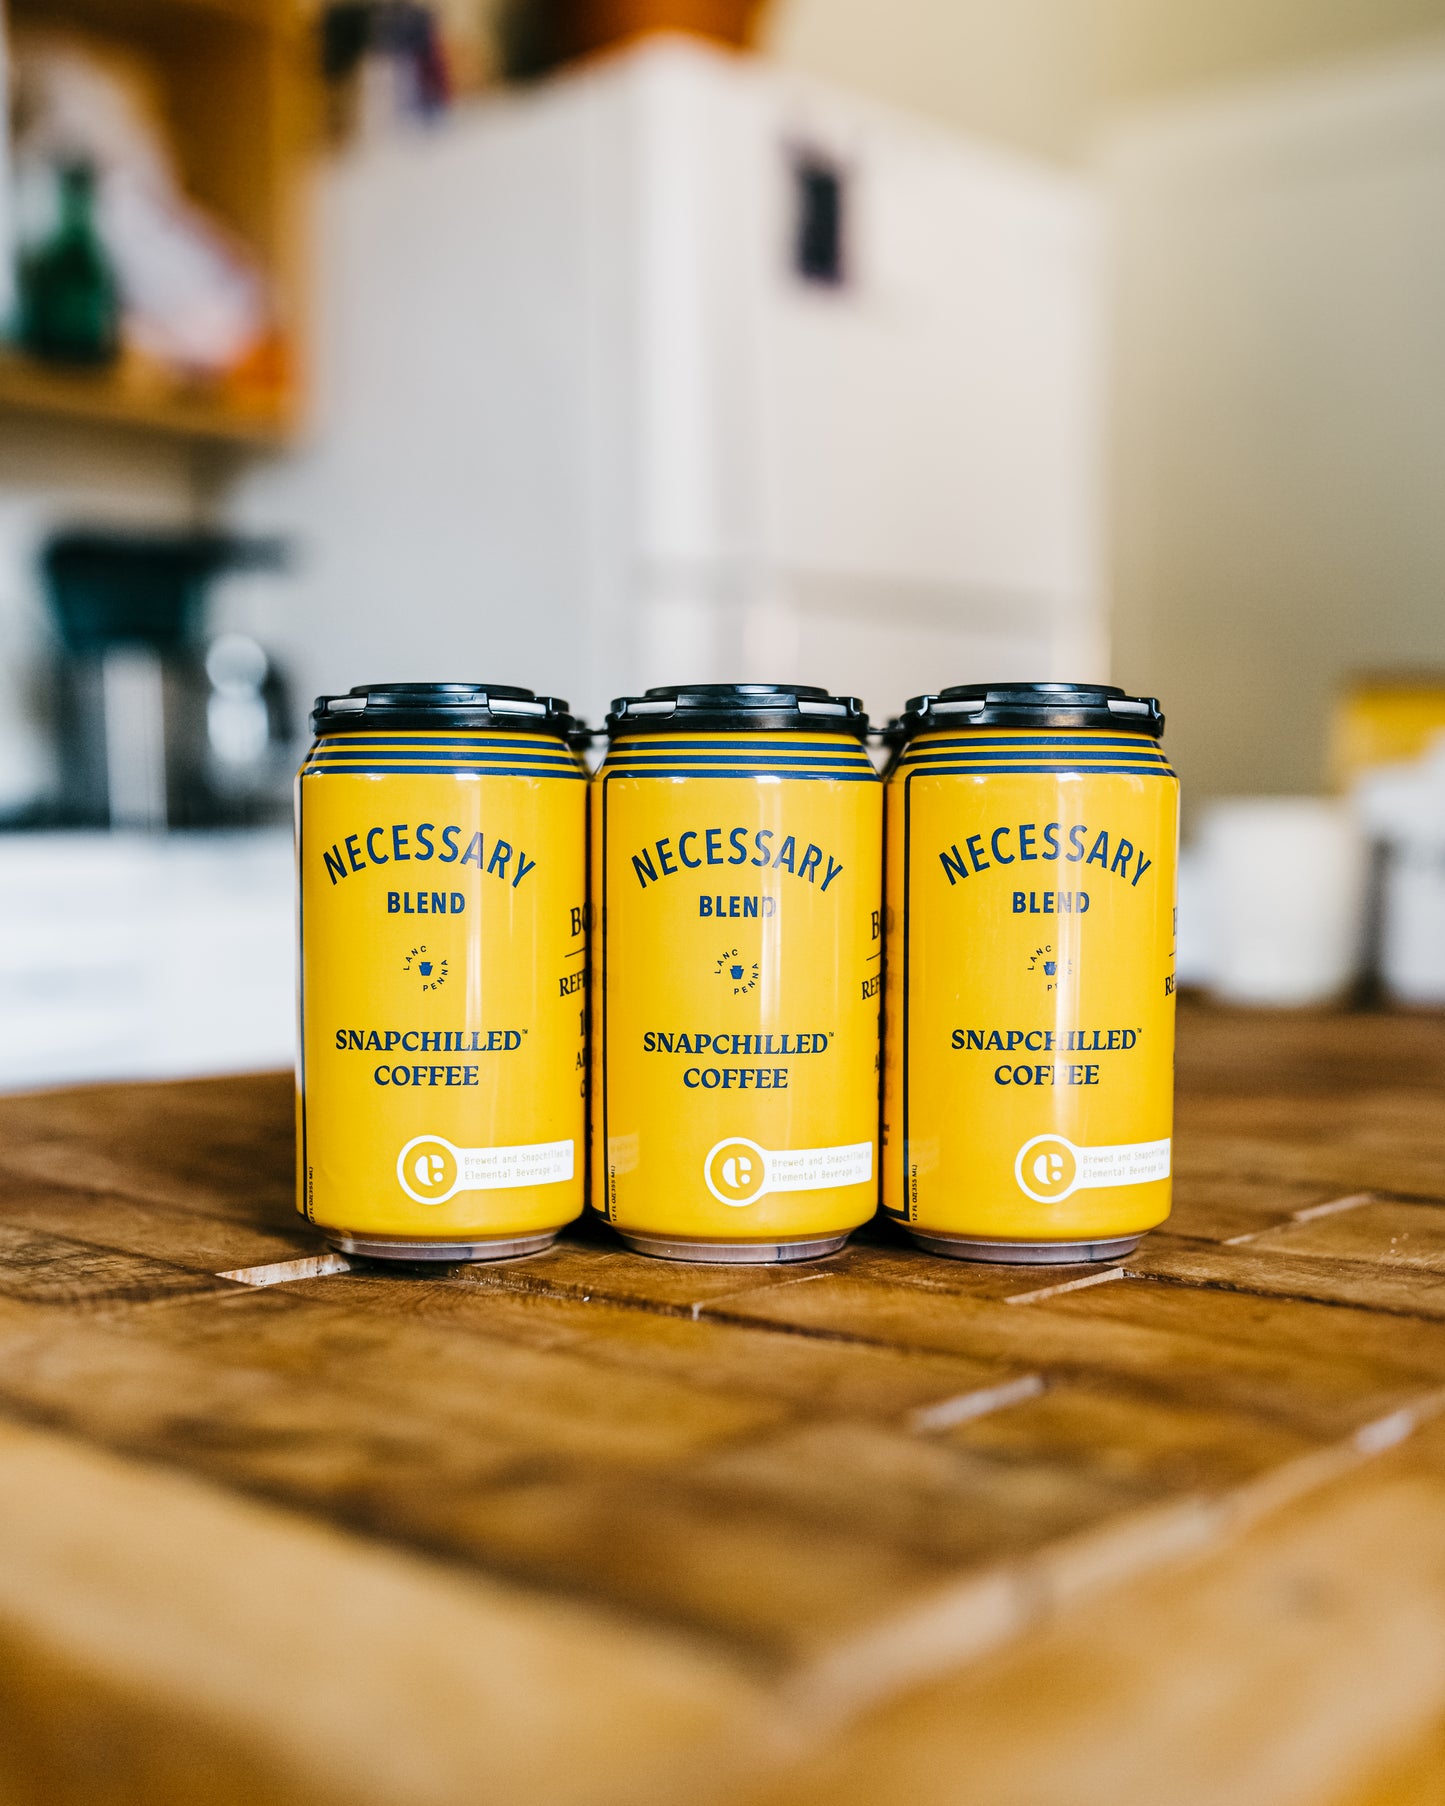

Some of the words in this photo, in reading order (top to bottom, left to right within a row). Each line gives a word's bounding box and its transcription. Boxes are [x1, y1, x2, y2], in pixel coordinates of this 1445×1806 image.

[323, 823, 536, 888] NECESSARY
[631, 827, 844, 892] NECESSARY
[938, 822, 1152, 887] NECESSARY
[387, 892, 466, 914] BLEND
[699, 896, 777, 918] BLEND
[1012, 891, 1090, 914] BLEND
[403, 945, 427, 971] LANC
[714, 949, 738, 974] LANC
[1027, 945, 1052, 970] LANC
[423, 959, 448, 991] PENNA
[734, 963, 759, 995] PENNA
[374, 1065, 479, 1086] COFFEE
[683, 1067, 789, 1089] COFFEE
[464, 1156, 498, 1166] Brewed
[502, 1155, 518, 1164] and
[771, 1158, 804, 1168] Brewed
[809, 1157, 823, 1165] and
[1082, 1154, 1114, 1164] Brewed
[1117, 1153, 1131, 1162] and
[464, 1169, 511, 1180] Elemental
[516, 1167, 550, 1177] Beverage
[771, 1171, 817, 1182] Elemental
[821, 1168, 853, 1179] Beverage
[1082, 1167, 1126, 1178] Elemental
[912, 1213, 918, 1221] 12
